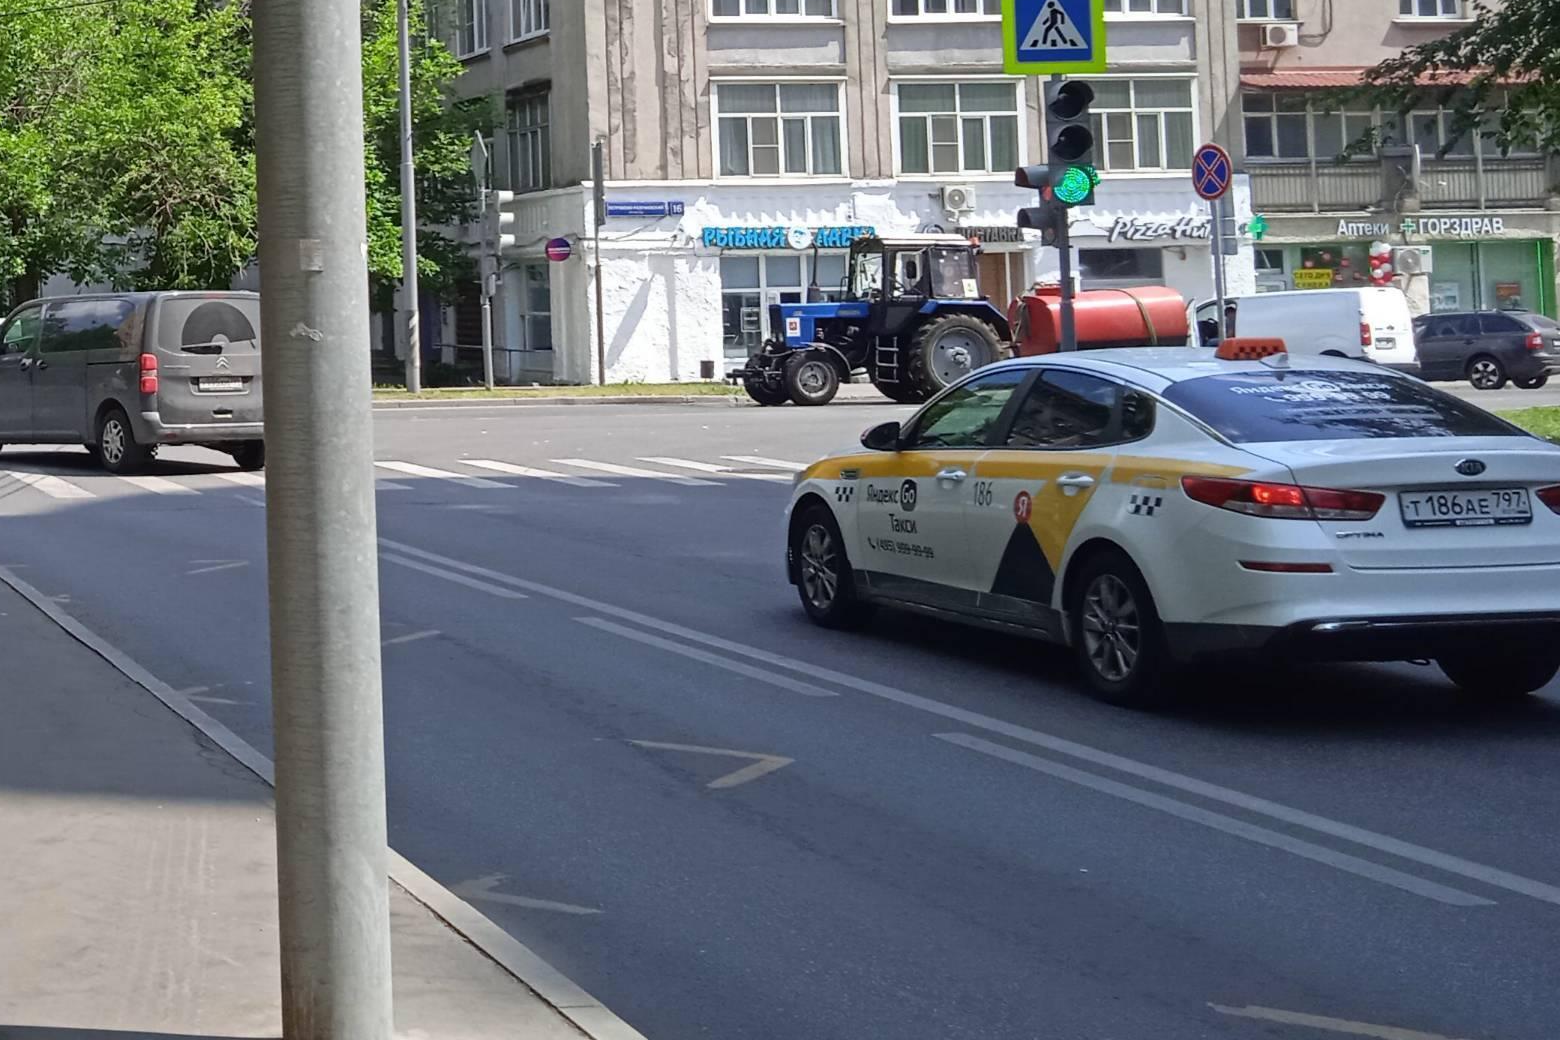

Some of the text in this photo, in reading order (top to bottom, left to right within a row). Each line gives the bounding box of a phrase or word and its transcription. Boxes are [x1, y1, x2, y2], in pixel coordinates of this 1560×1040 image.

[672, 204, 682, 213] 16
[702, 226, 786, 248] РЫБНАЯ
[1108, 217, 1172, 243] Pizza
[1336, 218, 1390, 237] Аптеки
[1418, 217, 1505, 237] ГОРЗДРАВ
[867, 483, 899, 505] Яндекс
[973, 481, 993, 506] 186
[1491, 491, 1522, 508] 797
[1017, 496, 1028, 517] Я
[888, 513, 918, 534] Такси
